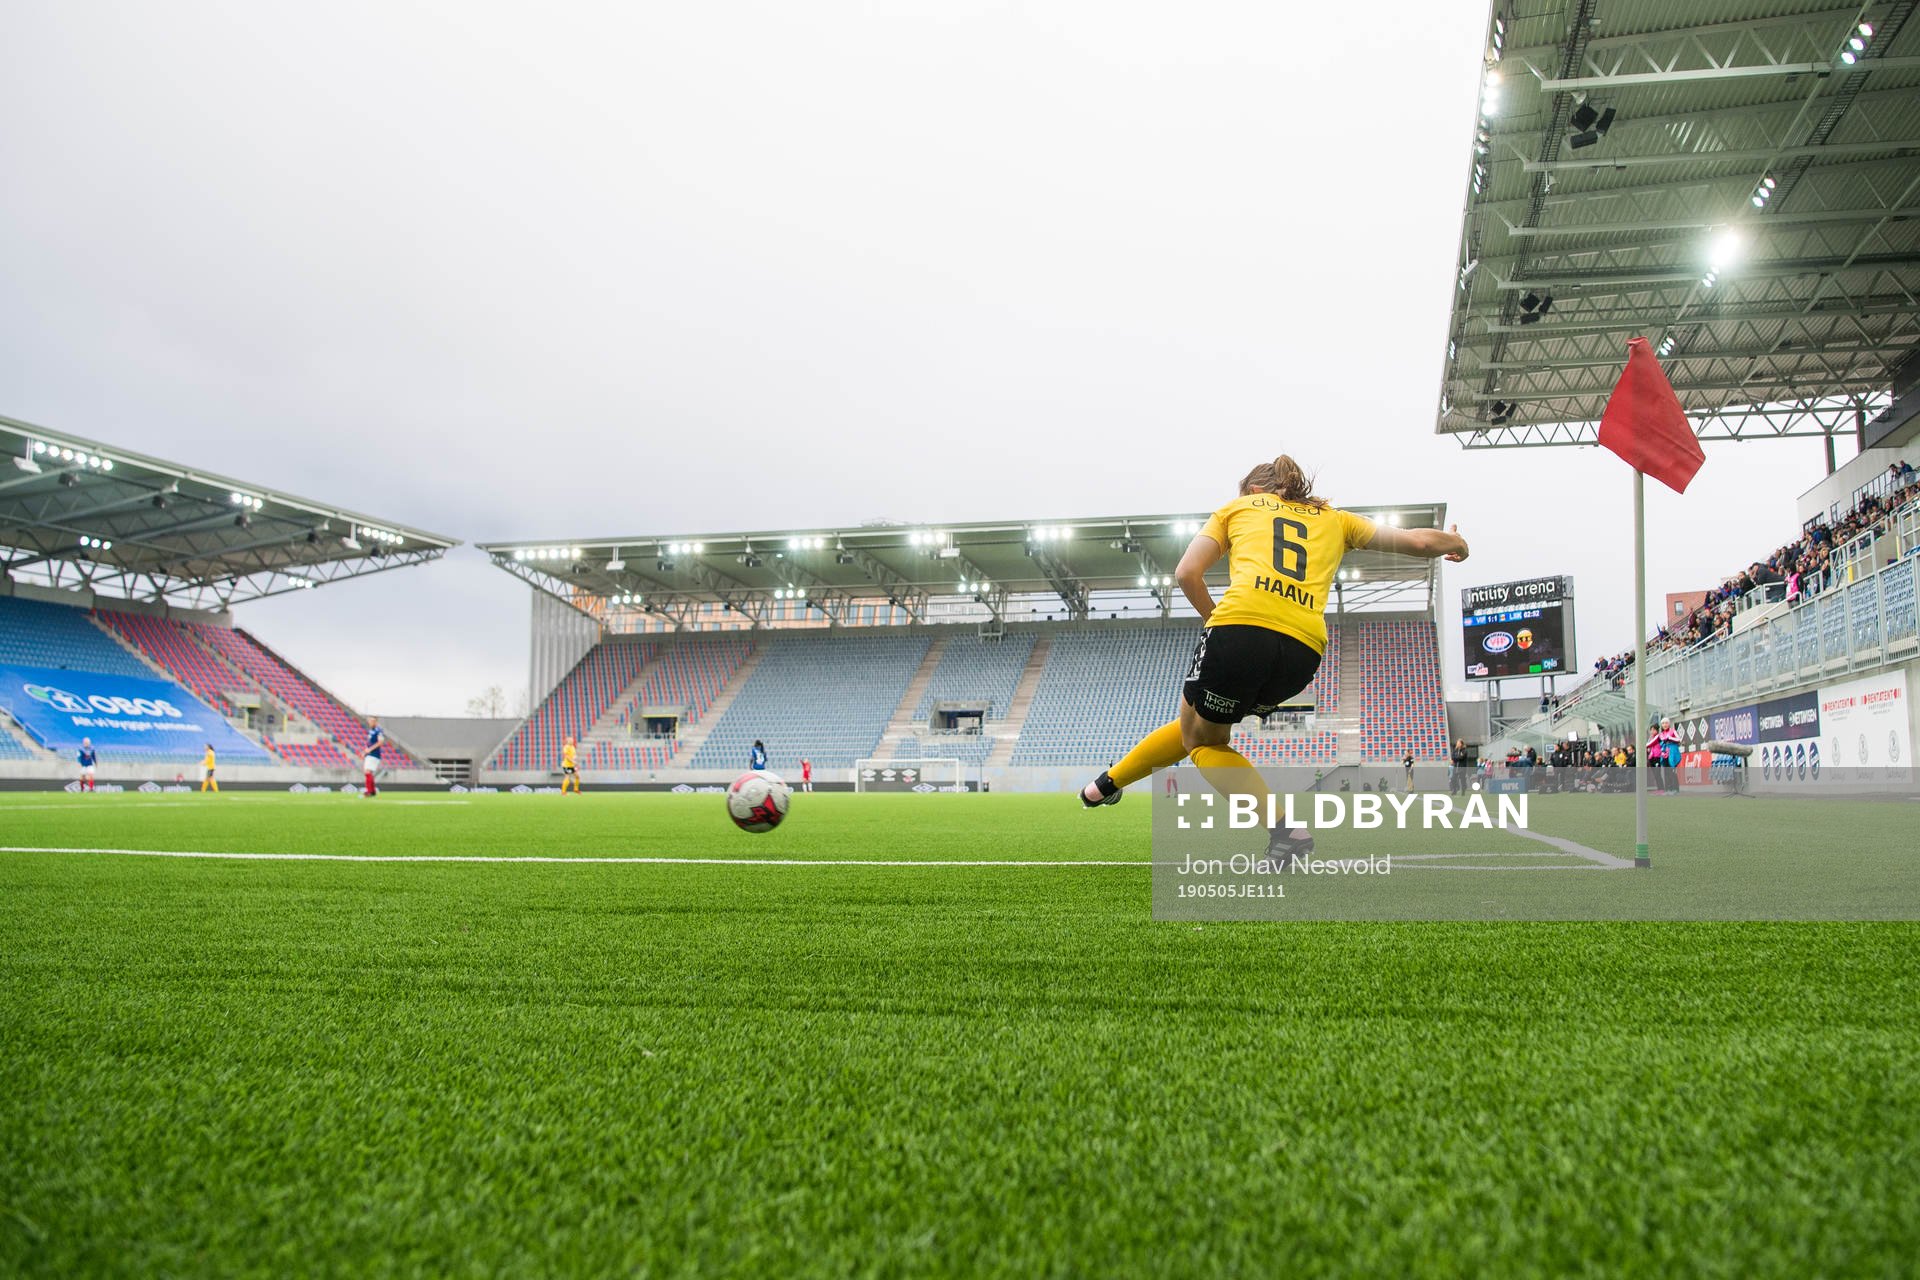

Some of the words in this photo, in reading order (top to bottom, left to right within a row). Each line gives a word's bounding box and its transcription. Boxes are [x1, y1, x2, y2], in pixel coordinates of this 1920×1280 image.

[1272, 516, 1308, 582] 6
[1254, 575, 1314, 609] HAAVI
[1514, 581, 1555, 597] arena
[88, 695, 182, 718] OBOS
[1203, 701, 1234, 714] HOTELS
[1204, 689, 1240, 709] THON
[1735, 712, 1753, 740] 1000
[938, 784, 970, 792] umbro
